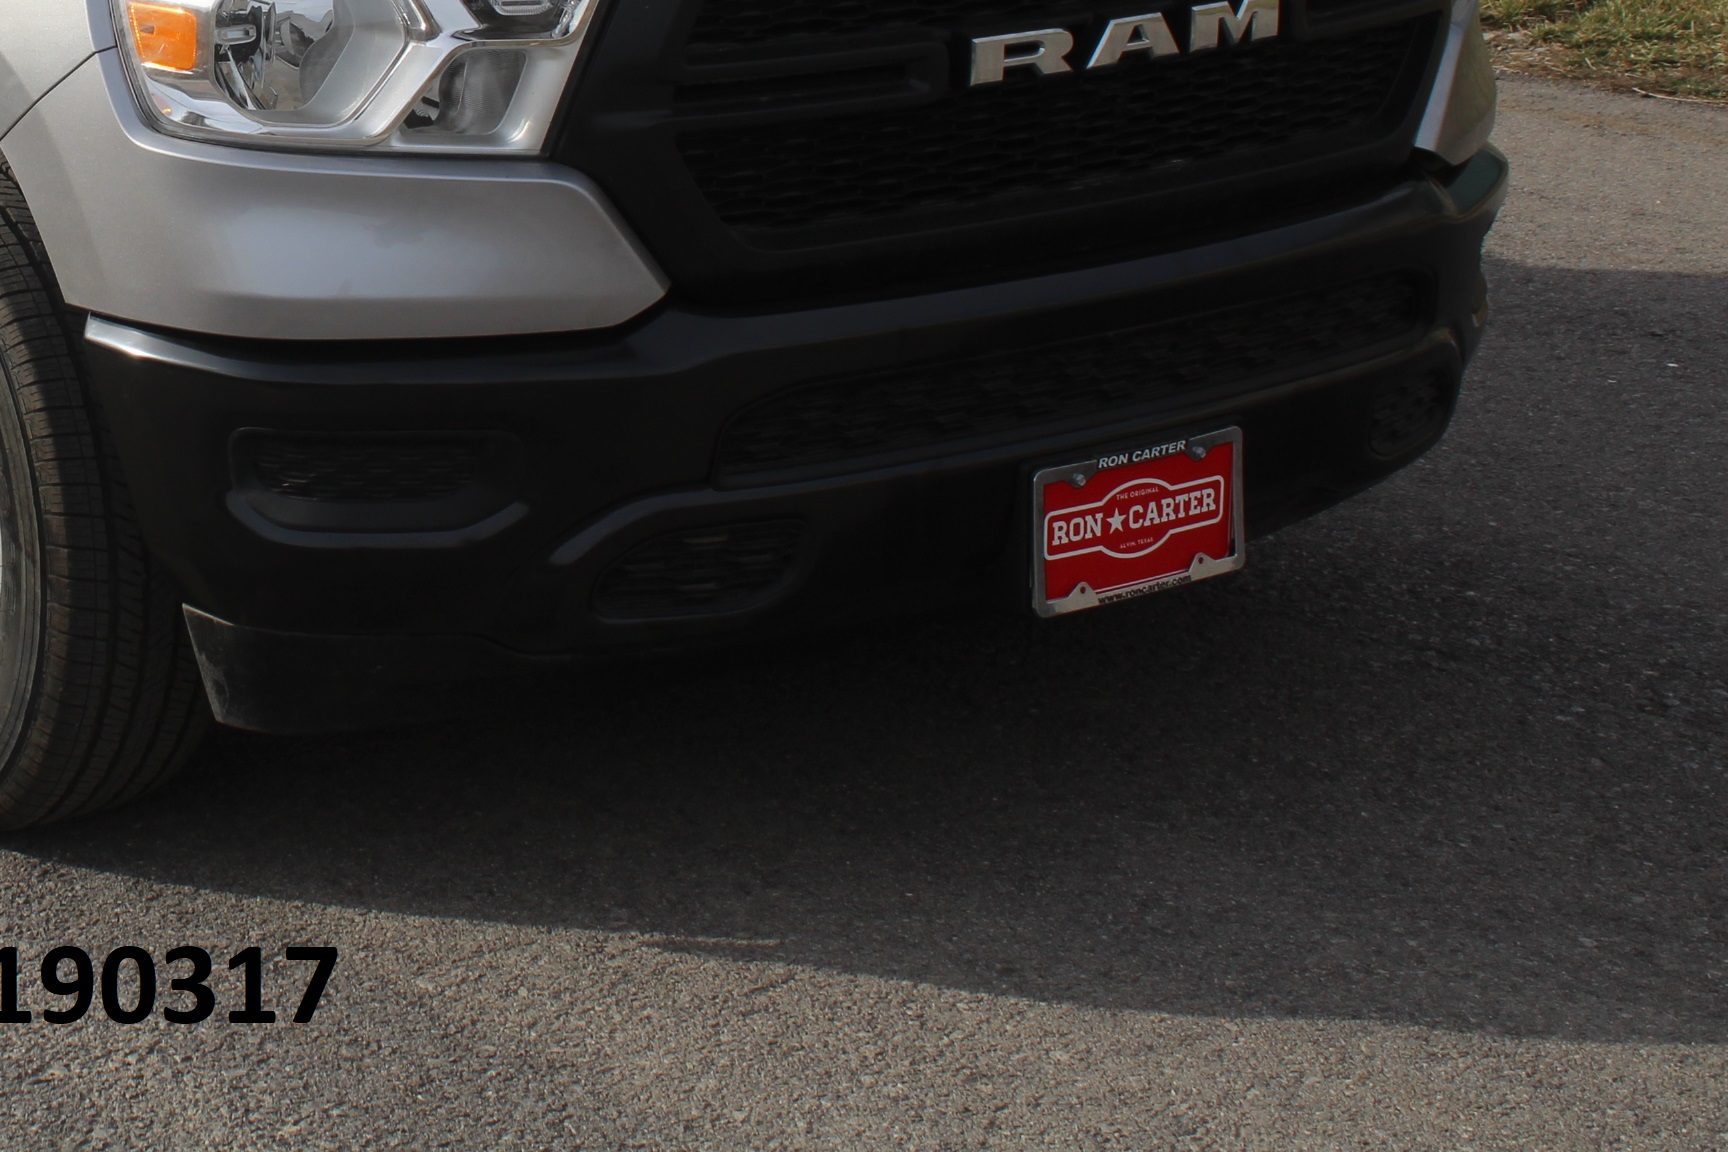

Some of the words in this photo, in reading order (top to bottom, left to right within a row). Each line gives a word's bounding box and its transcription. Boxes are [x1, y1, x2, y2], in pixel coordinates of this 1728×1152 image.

[1098, 453, 1128, 469] RON
[1132, 440, 1186, 462] CARTER
[1130, 486, 1159, 499] ORIGINAL
[1051, 513, 1104, 546] RON
[1128, 488, 1216, 529] CARTER
[1098, 574, 1192, 605] www.roncarter.com
